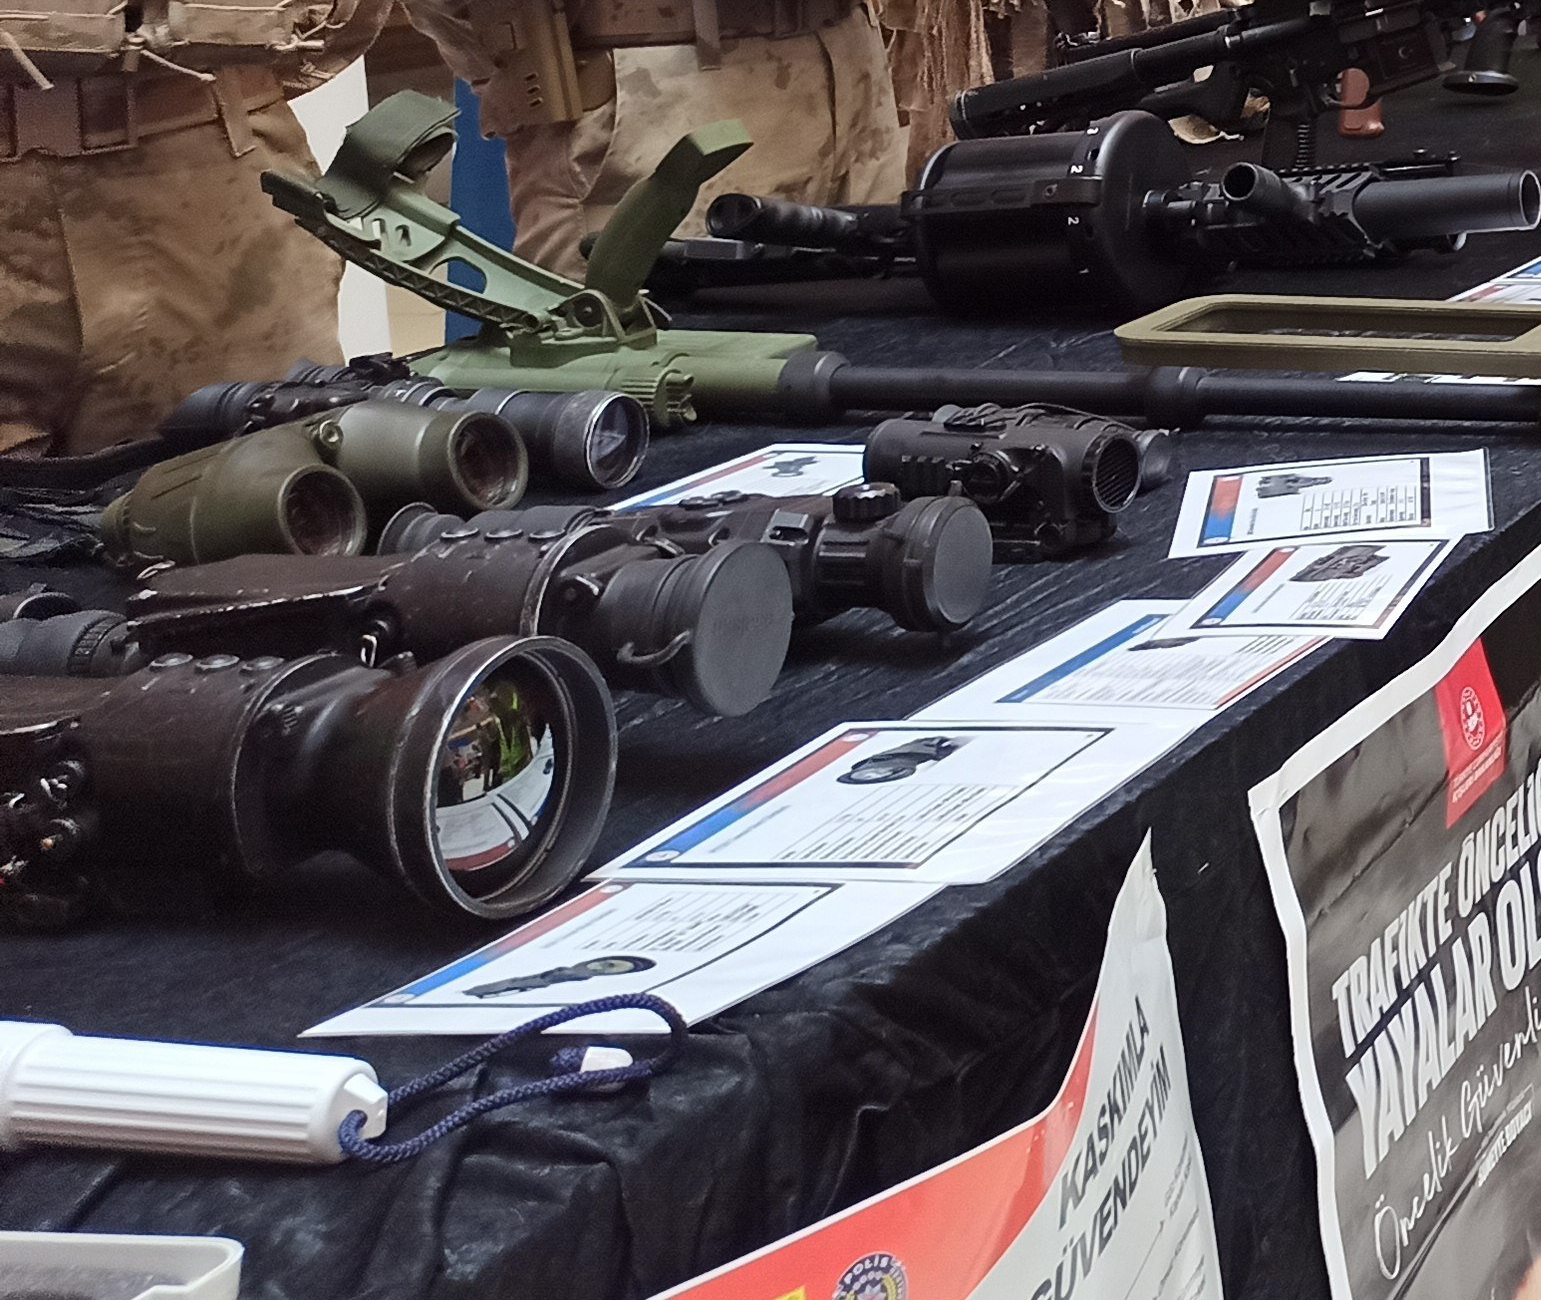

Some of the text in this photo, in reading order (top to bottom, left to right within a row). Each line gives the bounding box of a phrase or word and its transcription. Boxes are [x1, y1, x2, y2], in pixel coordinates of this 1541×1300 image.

[1331, 862, 1453, 1059] TRAFİKTE
[1346, 911, 1498, 1180] YAYALAR
[1059, 994, 1151, 1232] KASKIMLA
[1374, 1114, 1463, 1280] Öncelik
